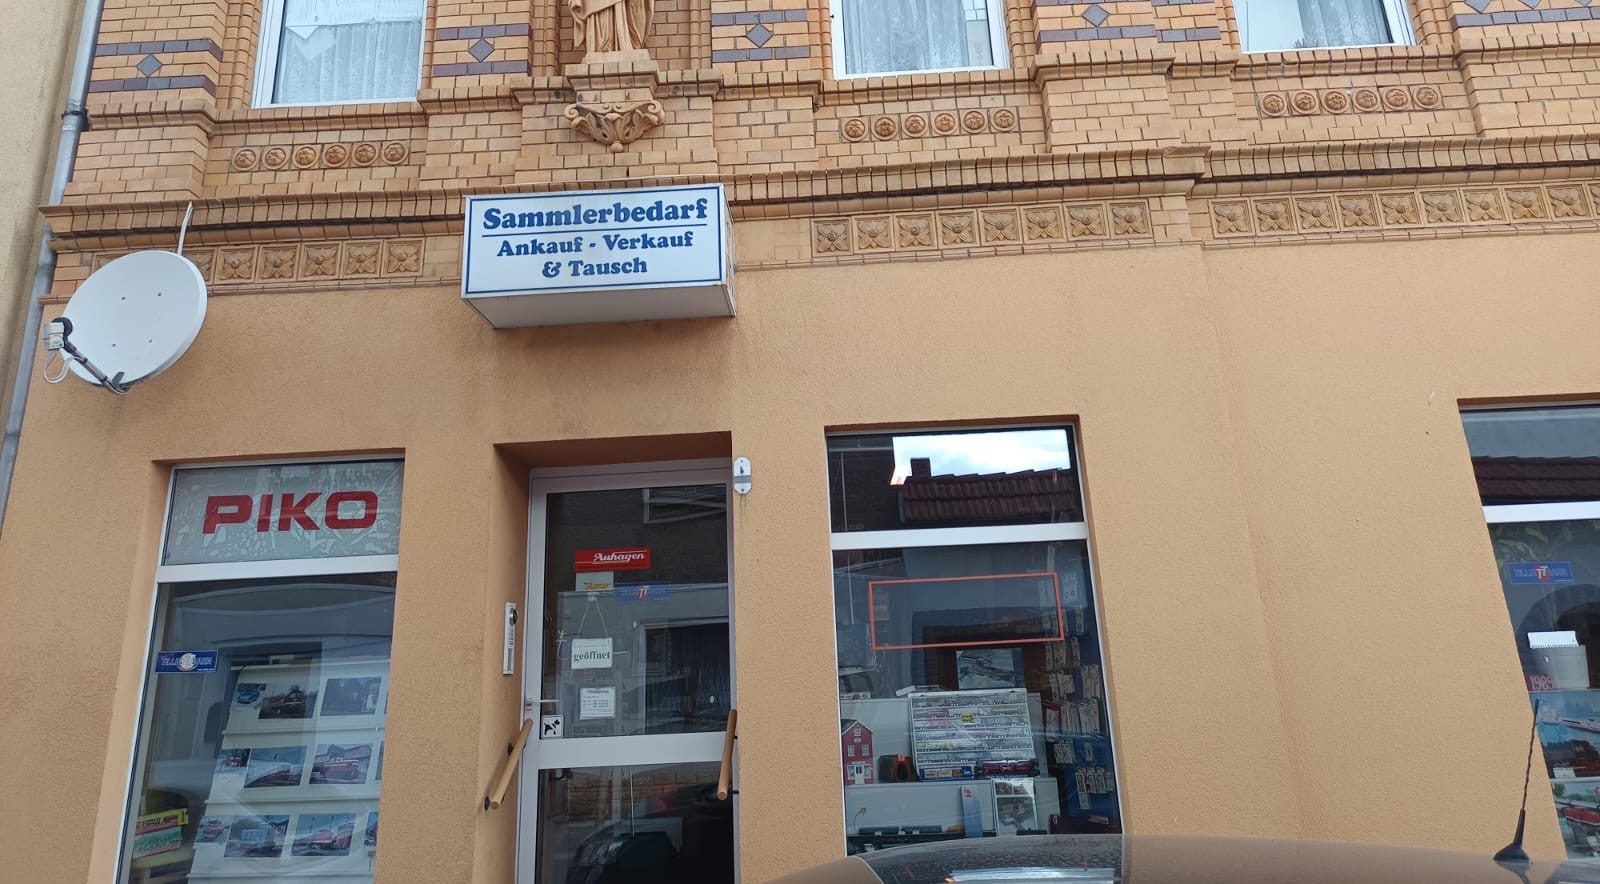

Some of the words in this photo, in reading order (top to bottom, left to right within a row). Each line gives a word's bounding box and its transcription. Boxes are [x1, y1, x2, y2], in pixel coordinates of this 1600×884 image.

[483, 198, 708, 230] Sammlerbedarf
[497, 237, 583, 257] Ankauf
[602, 231, 694, 251] Verkauf
[542, 261, 561, 278] &
[568, 257, 648, 277] Tausch
[203, 491, 378, 534] PIKO
[592, 552, 645, 563] Auhagen
[573, 650, 610, 662] geöffnet
